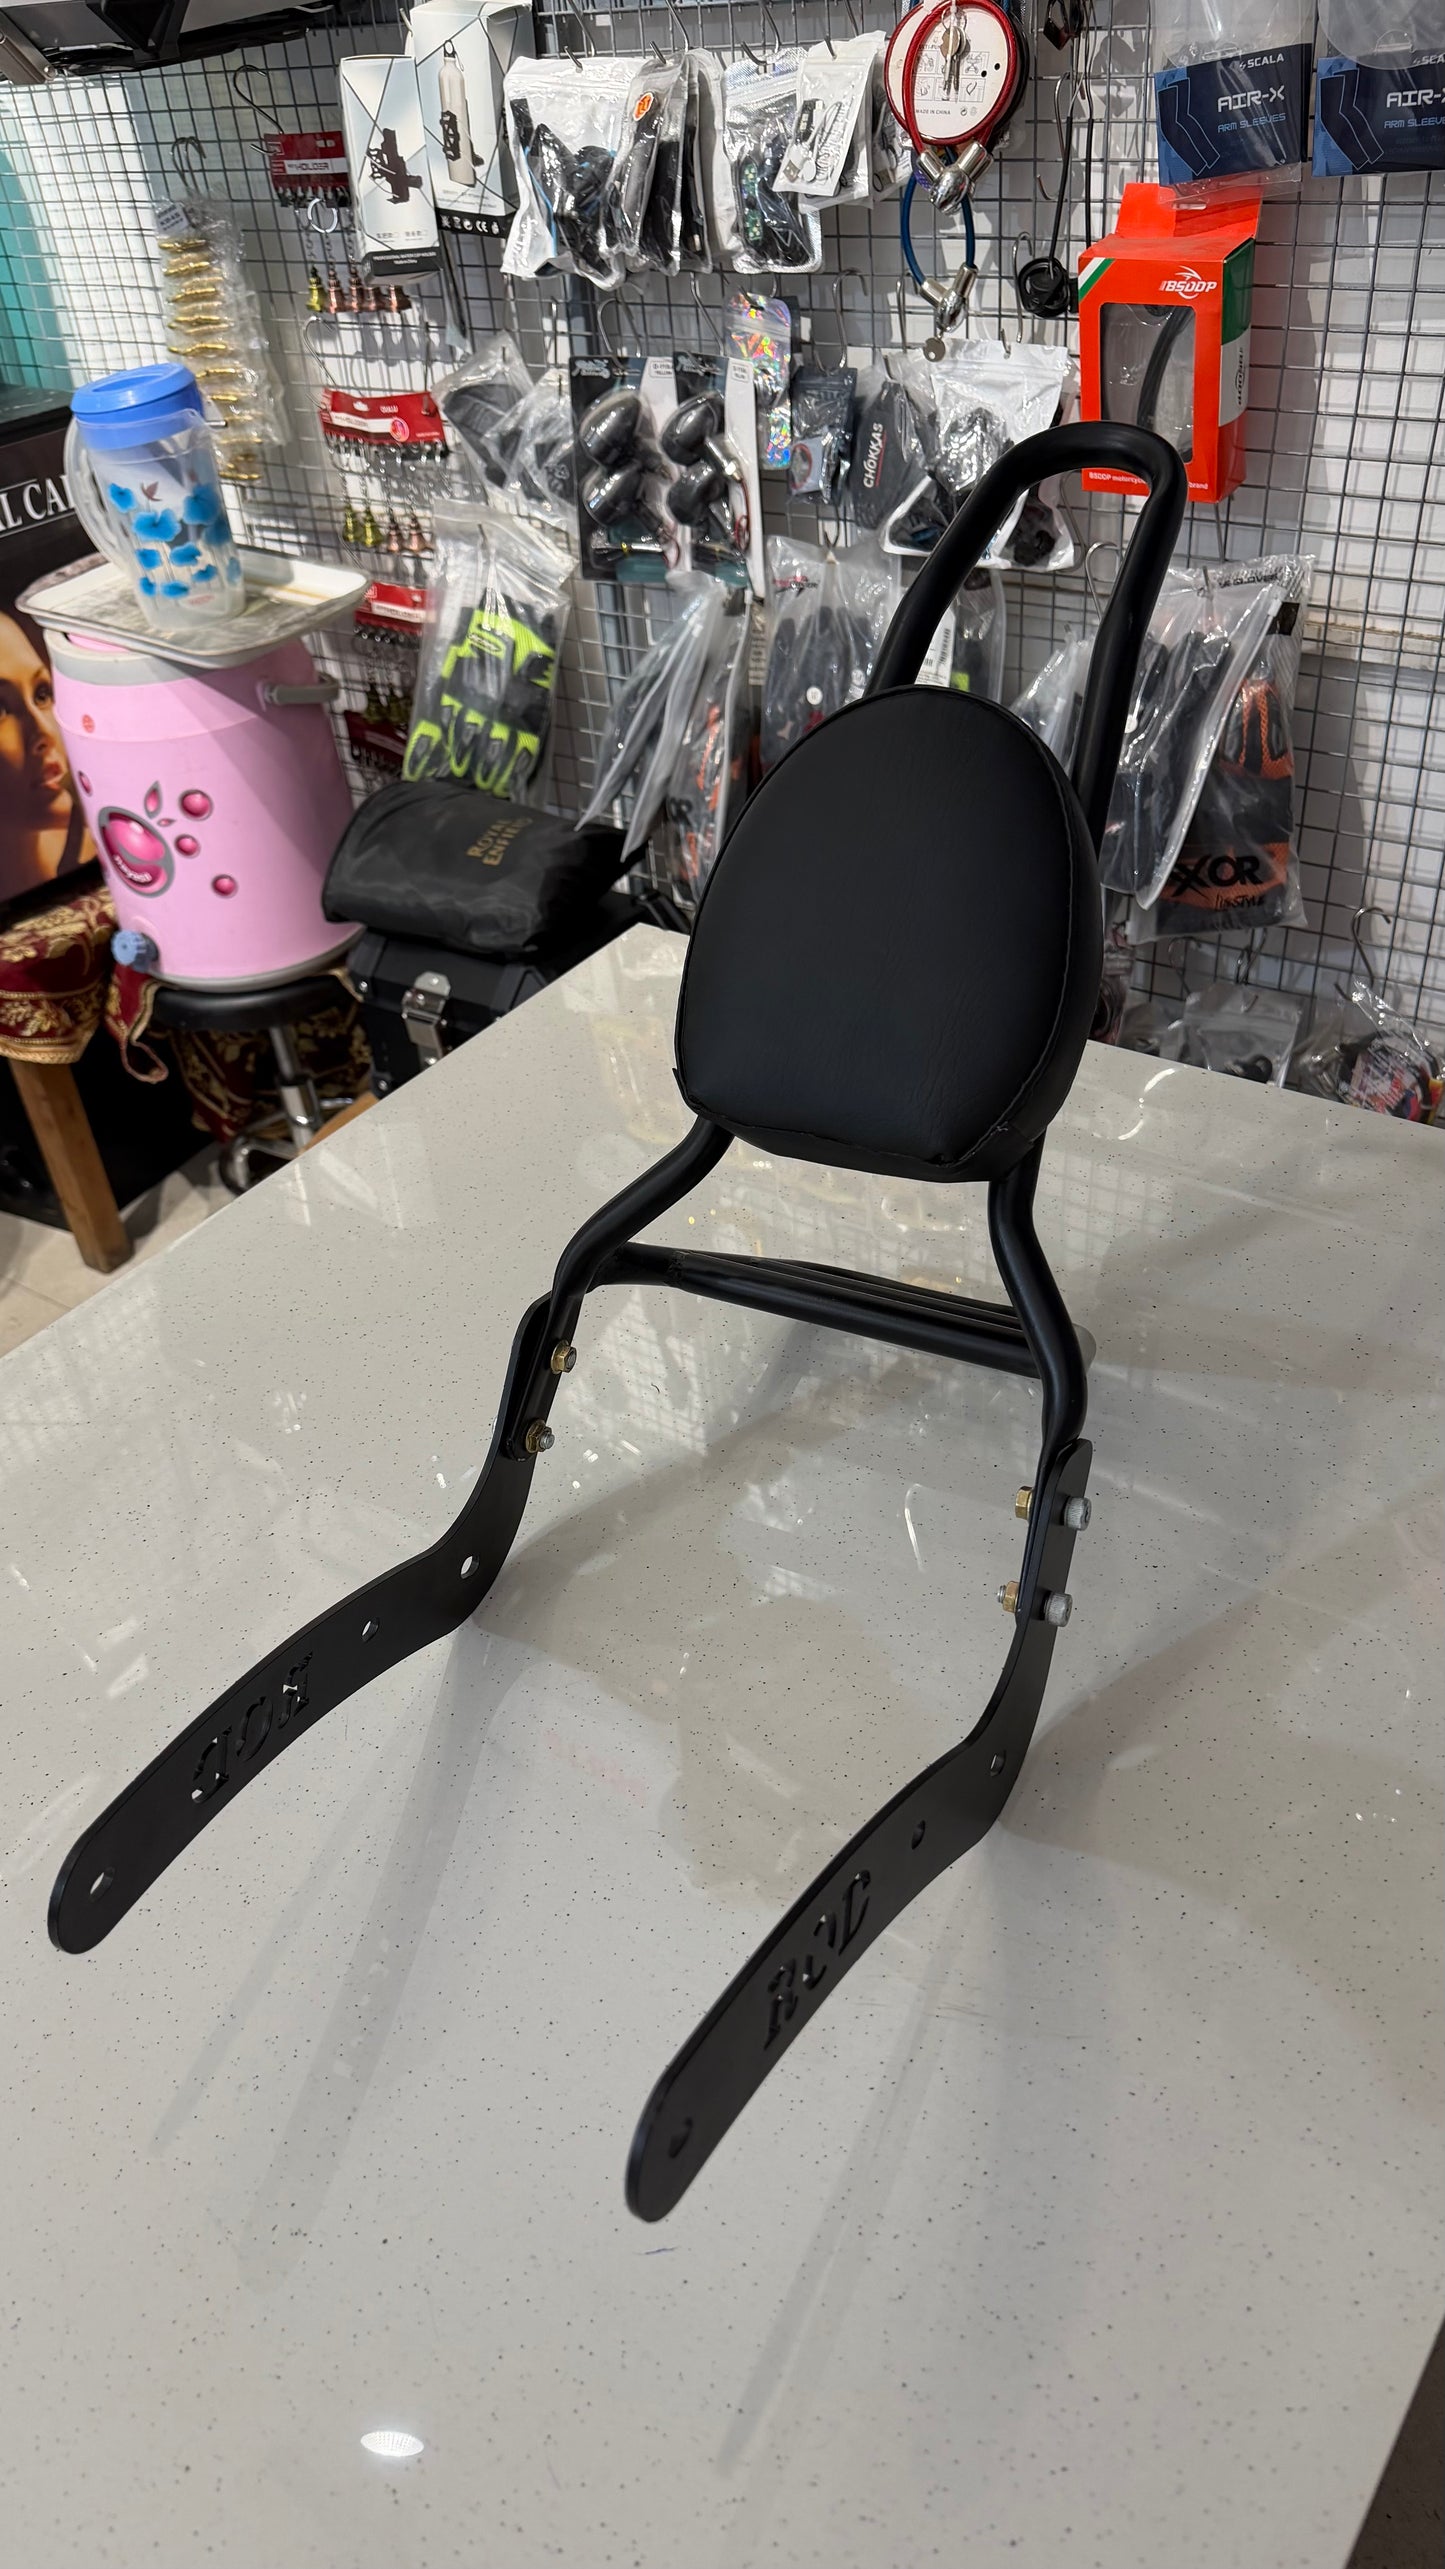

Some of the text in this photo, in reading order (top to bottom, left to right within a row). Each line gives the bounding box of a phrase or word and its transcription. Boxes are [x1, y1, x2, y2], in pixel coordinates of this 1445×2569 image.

[1247, 53, 1285, 69] SCALA
[1217, 85, 1285, 113] AIR-X
[1217, 112, 1286, 134] ARM SLEEVES
[1383, 119, 1405, 129] ARM
[862, 421, 884, 489] CHOKKAS
[0, 492, 23, 532] L
